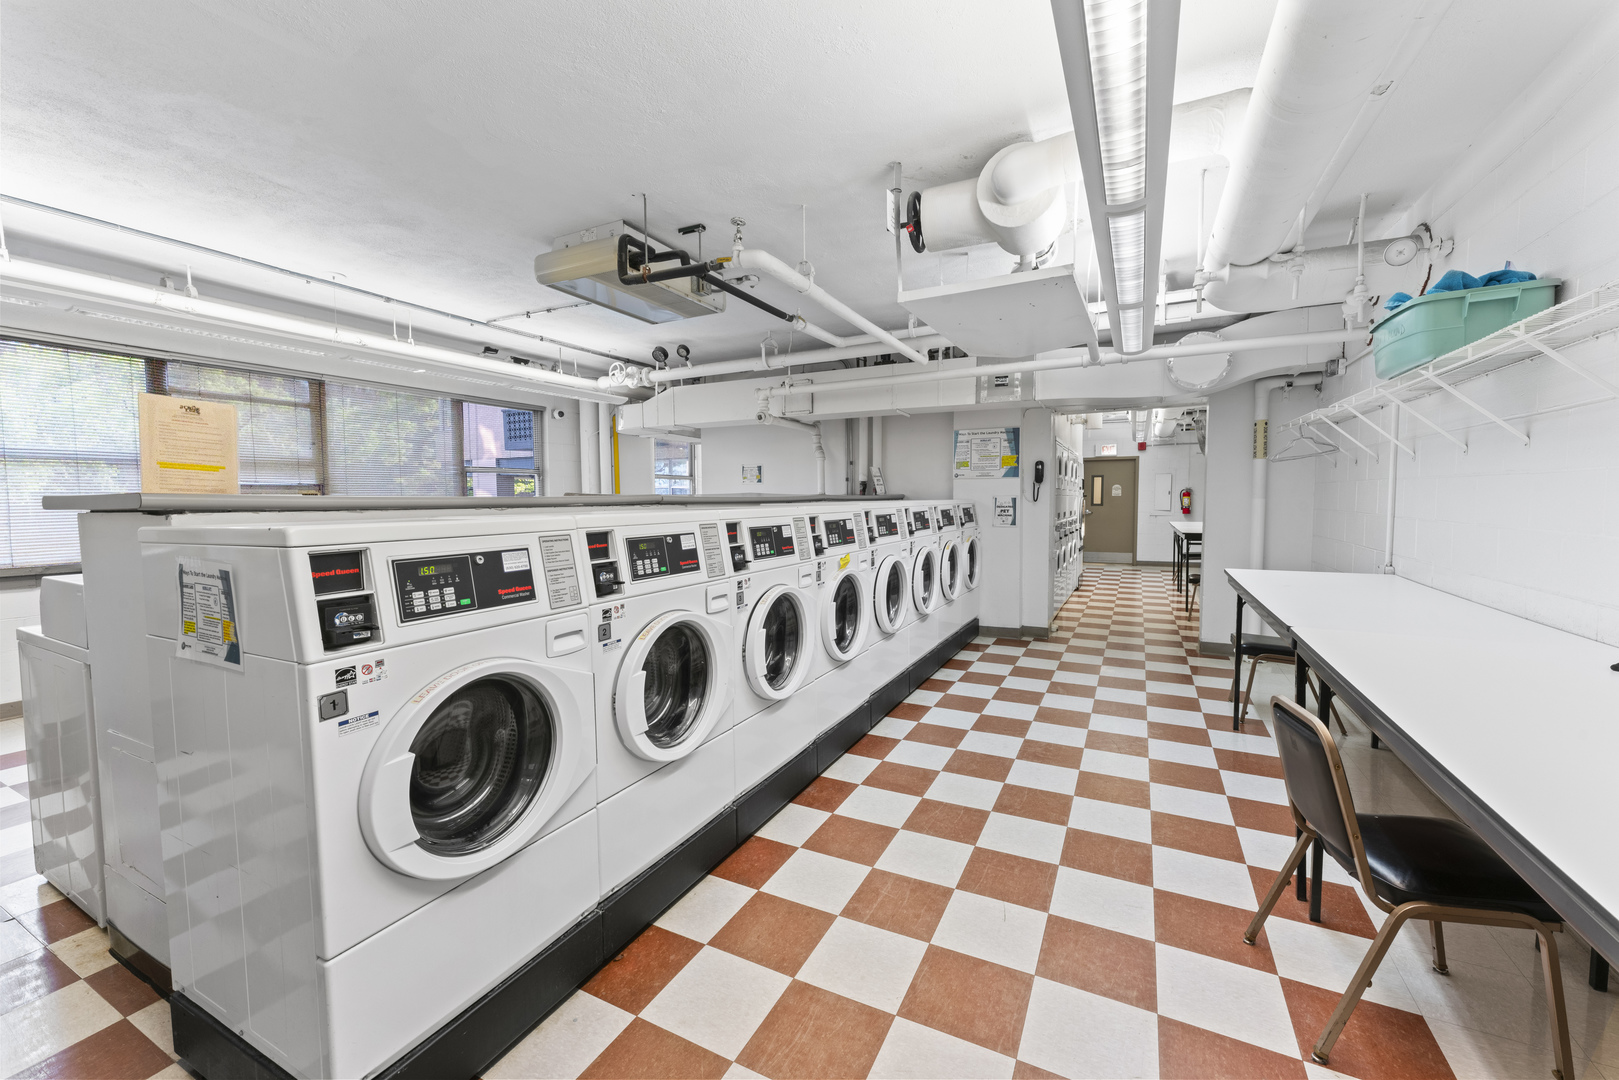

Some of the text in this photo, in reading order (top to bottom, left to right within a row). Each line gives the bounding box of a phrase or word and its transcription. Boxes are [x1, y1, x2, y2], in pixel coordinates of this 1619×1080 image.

[312, 570, 335, 578] Speed
[603, 628, 607, 636] 2
[413, 680, 444, 703] LEAVE
[330, 700, 337, 710] 1
[349, 714, 369, 723] NOTICE
